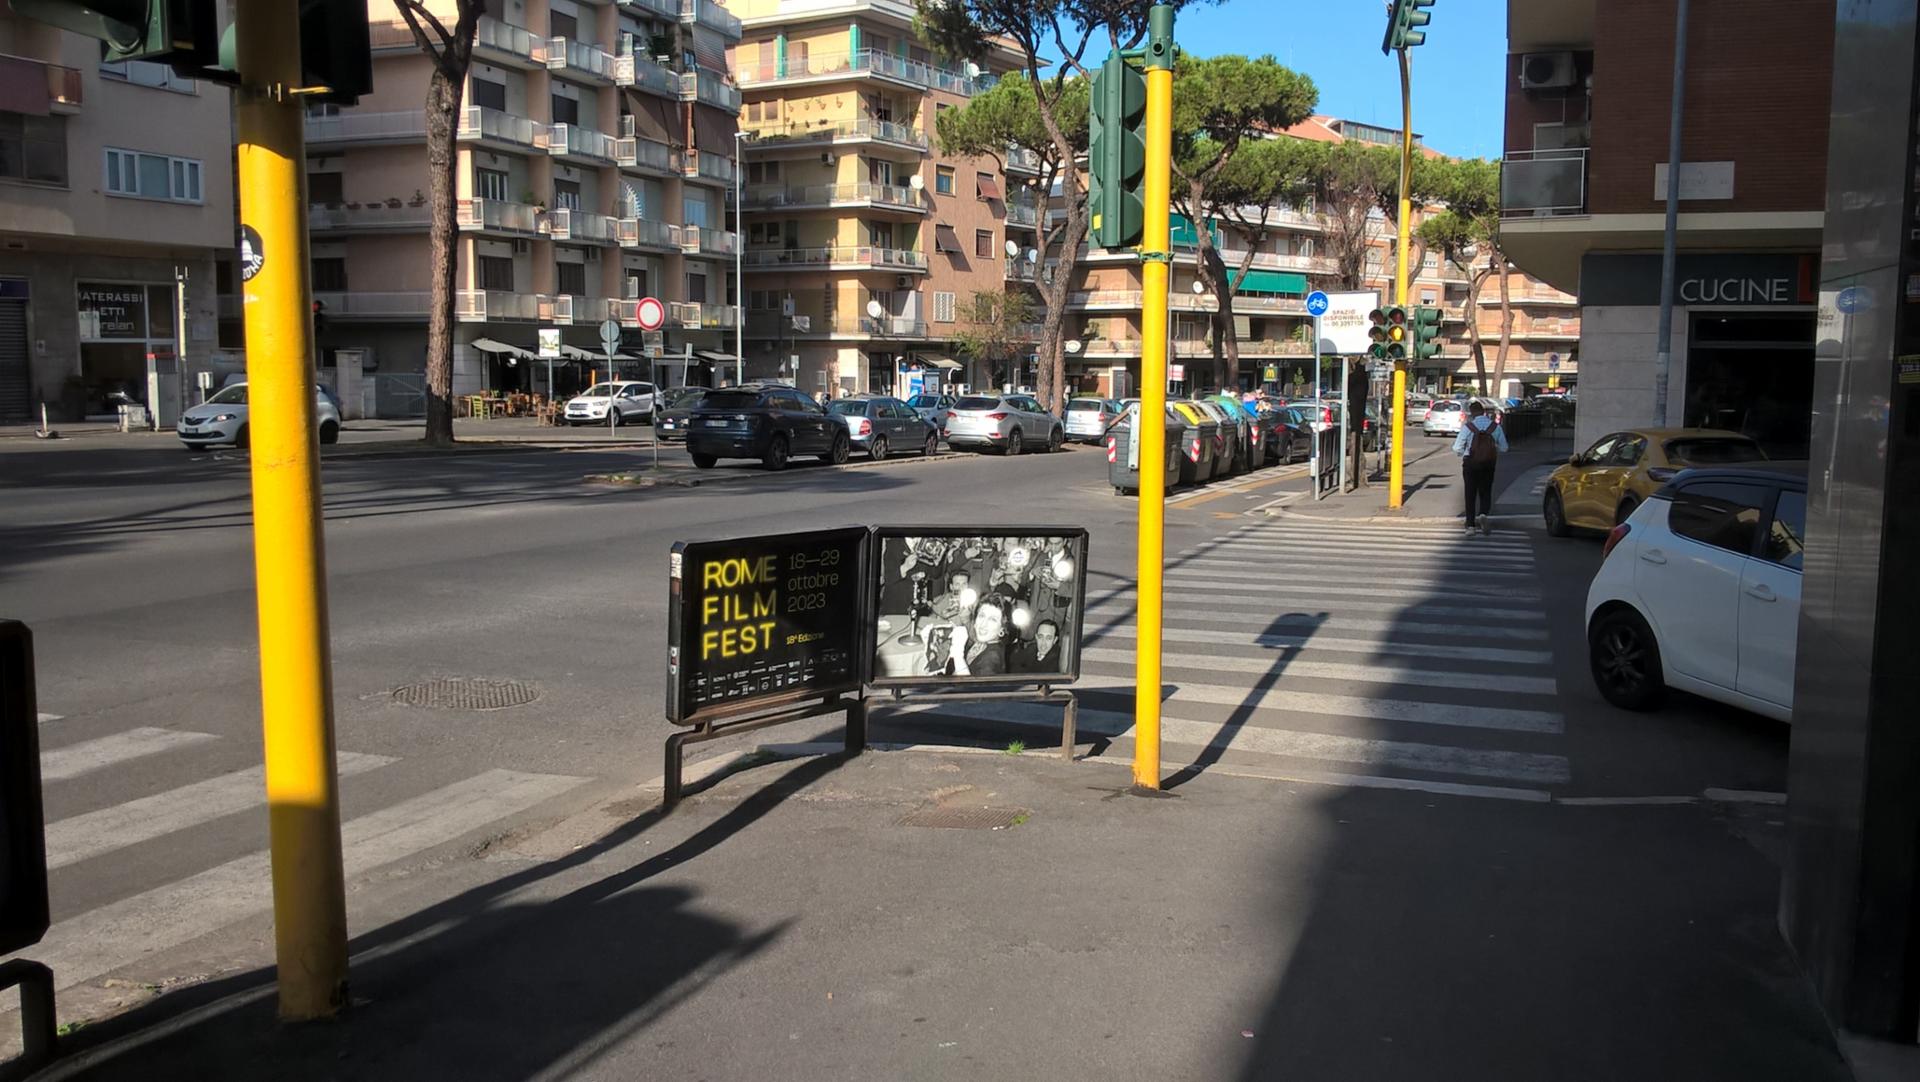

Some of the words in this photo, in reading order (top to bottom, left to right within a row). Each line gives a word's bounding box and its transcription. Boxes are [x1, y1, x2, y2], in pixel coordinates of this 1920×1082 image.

[1679, 278, 1789, 302] CUCINE
[96, 306, 125, 316] ETTI
[703, 555, 777, 590] ROME
[787, 571, 839, 591] ottobre
[703, 589, 777, 625] FILM
[787, 592, 826, 613] 2023
[702, 622, 776, 660] FEST
